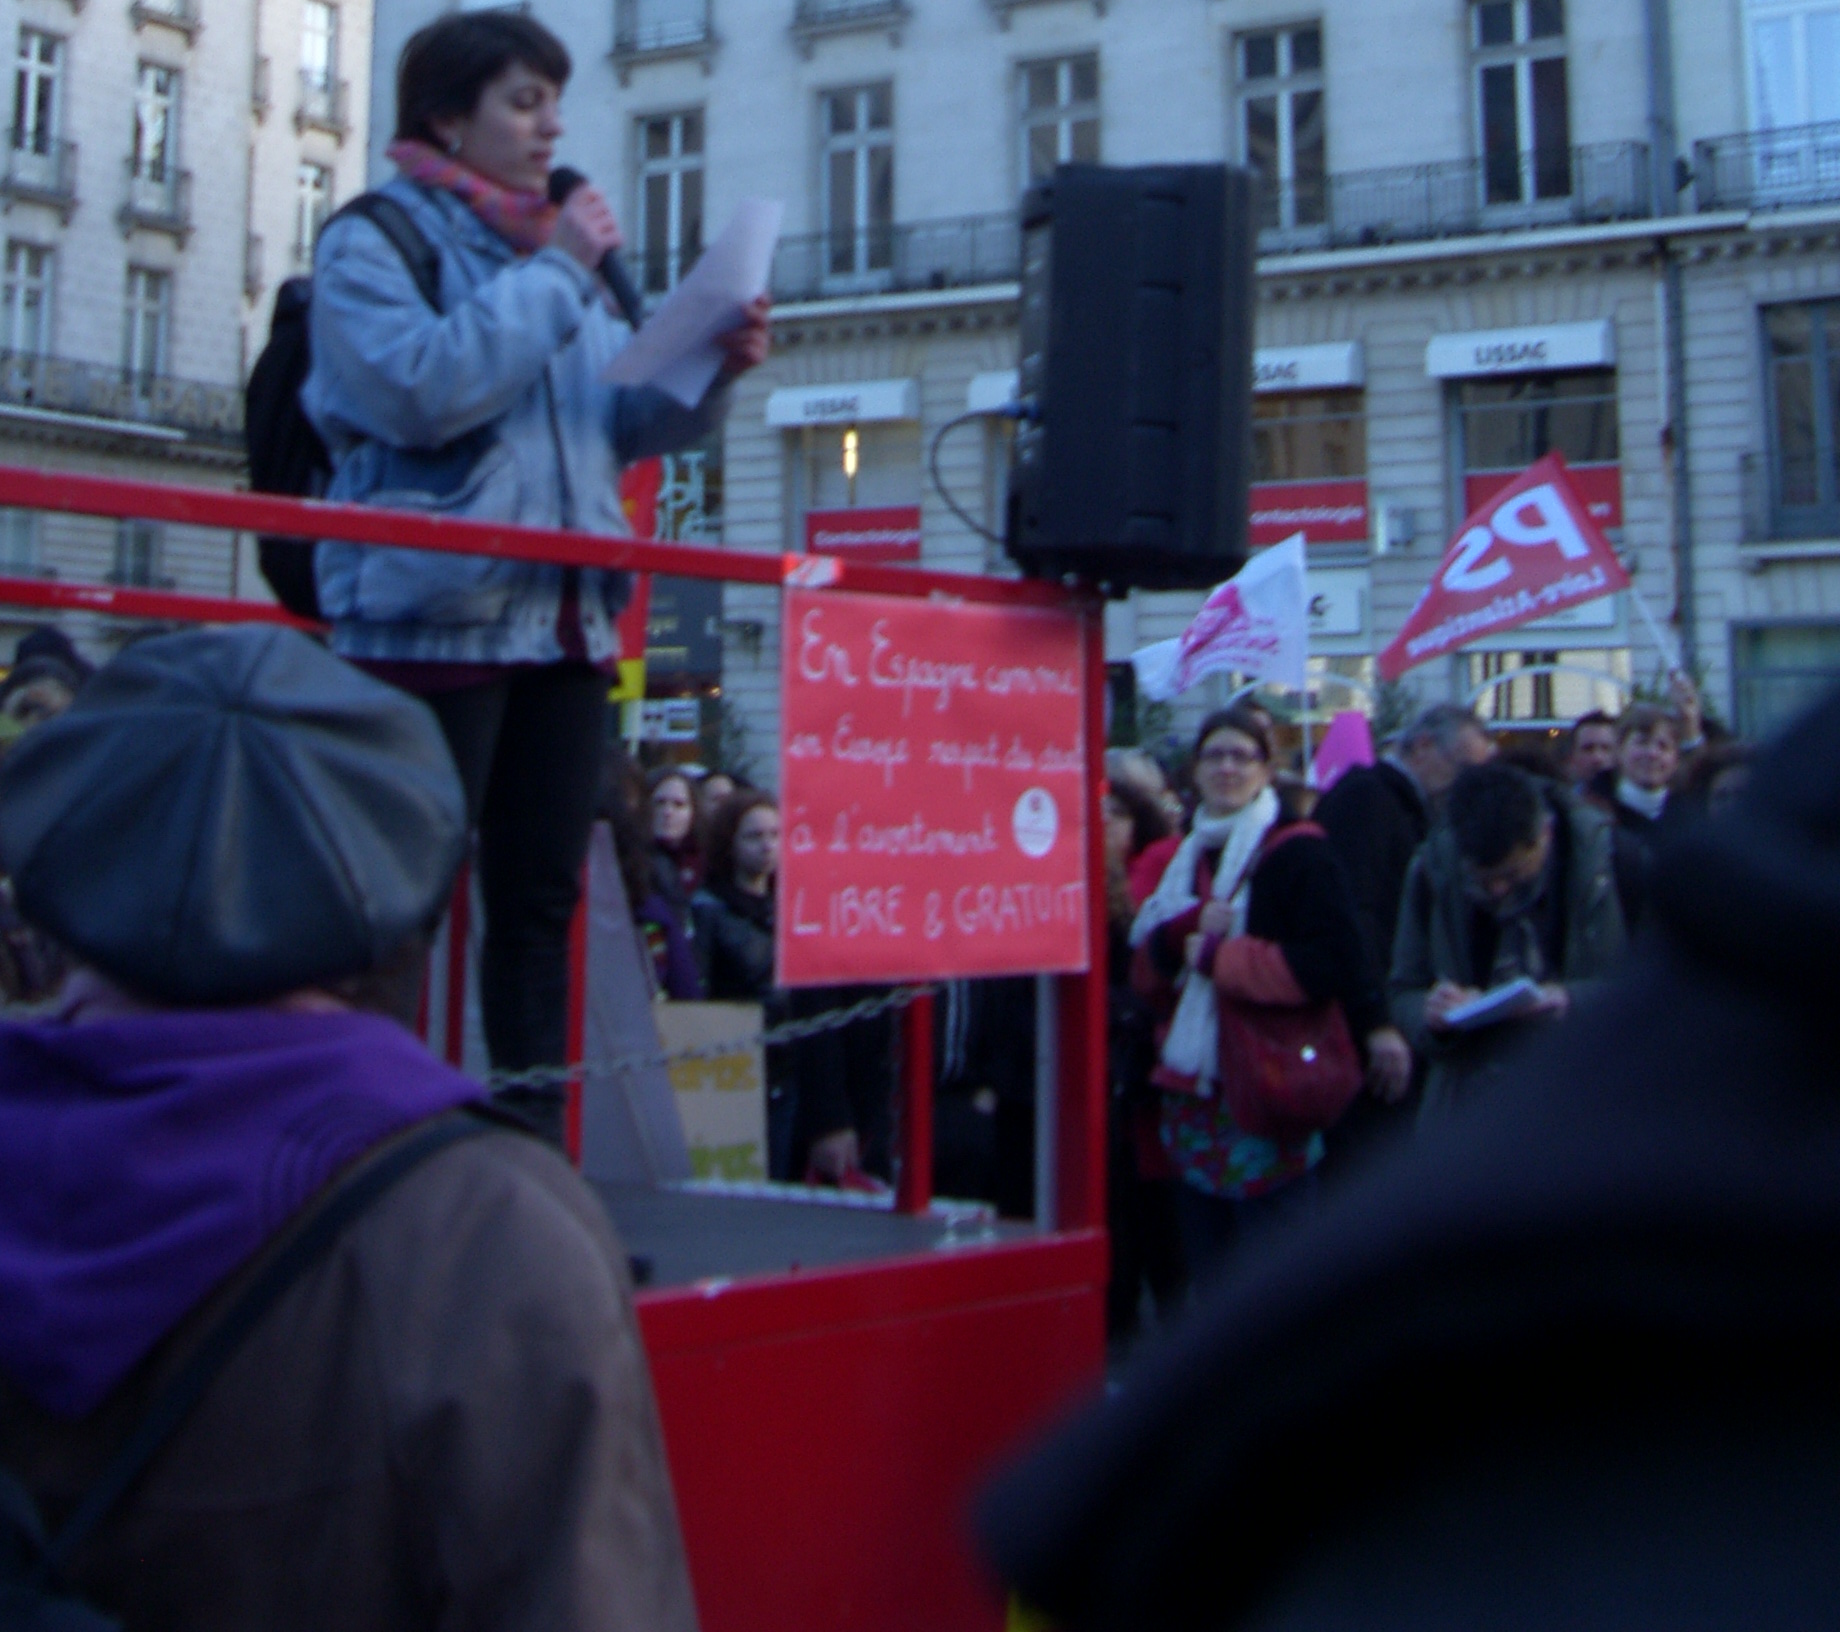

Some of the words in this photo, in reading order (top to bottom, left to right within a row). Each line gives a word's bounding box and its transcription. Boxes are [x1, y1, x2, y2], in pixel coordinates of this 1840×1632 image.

[1475, 340, 1547, 366] LISSAC
[800, 607, 859, 687] En
[869, 618, 978, 718] Espagne
[791, 883, 905, 939] LIBRE
[952, 880, 1086, 934] GRATUIT
